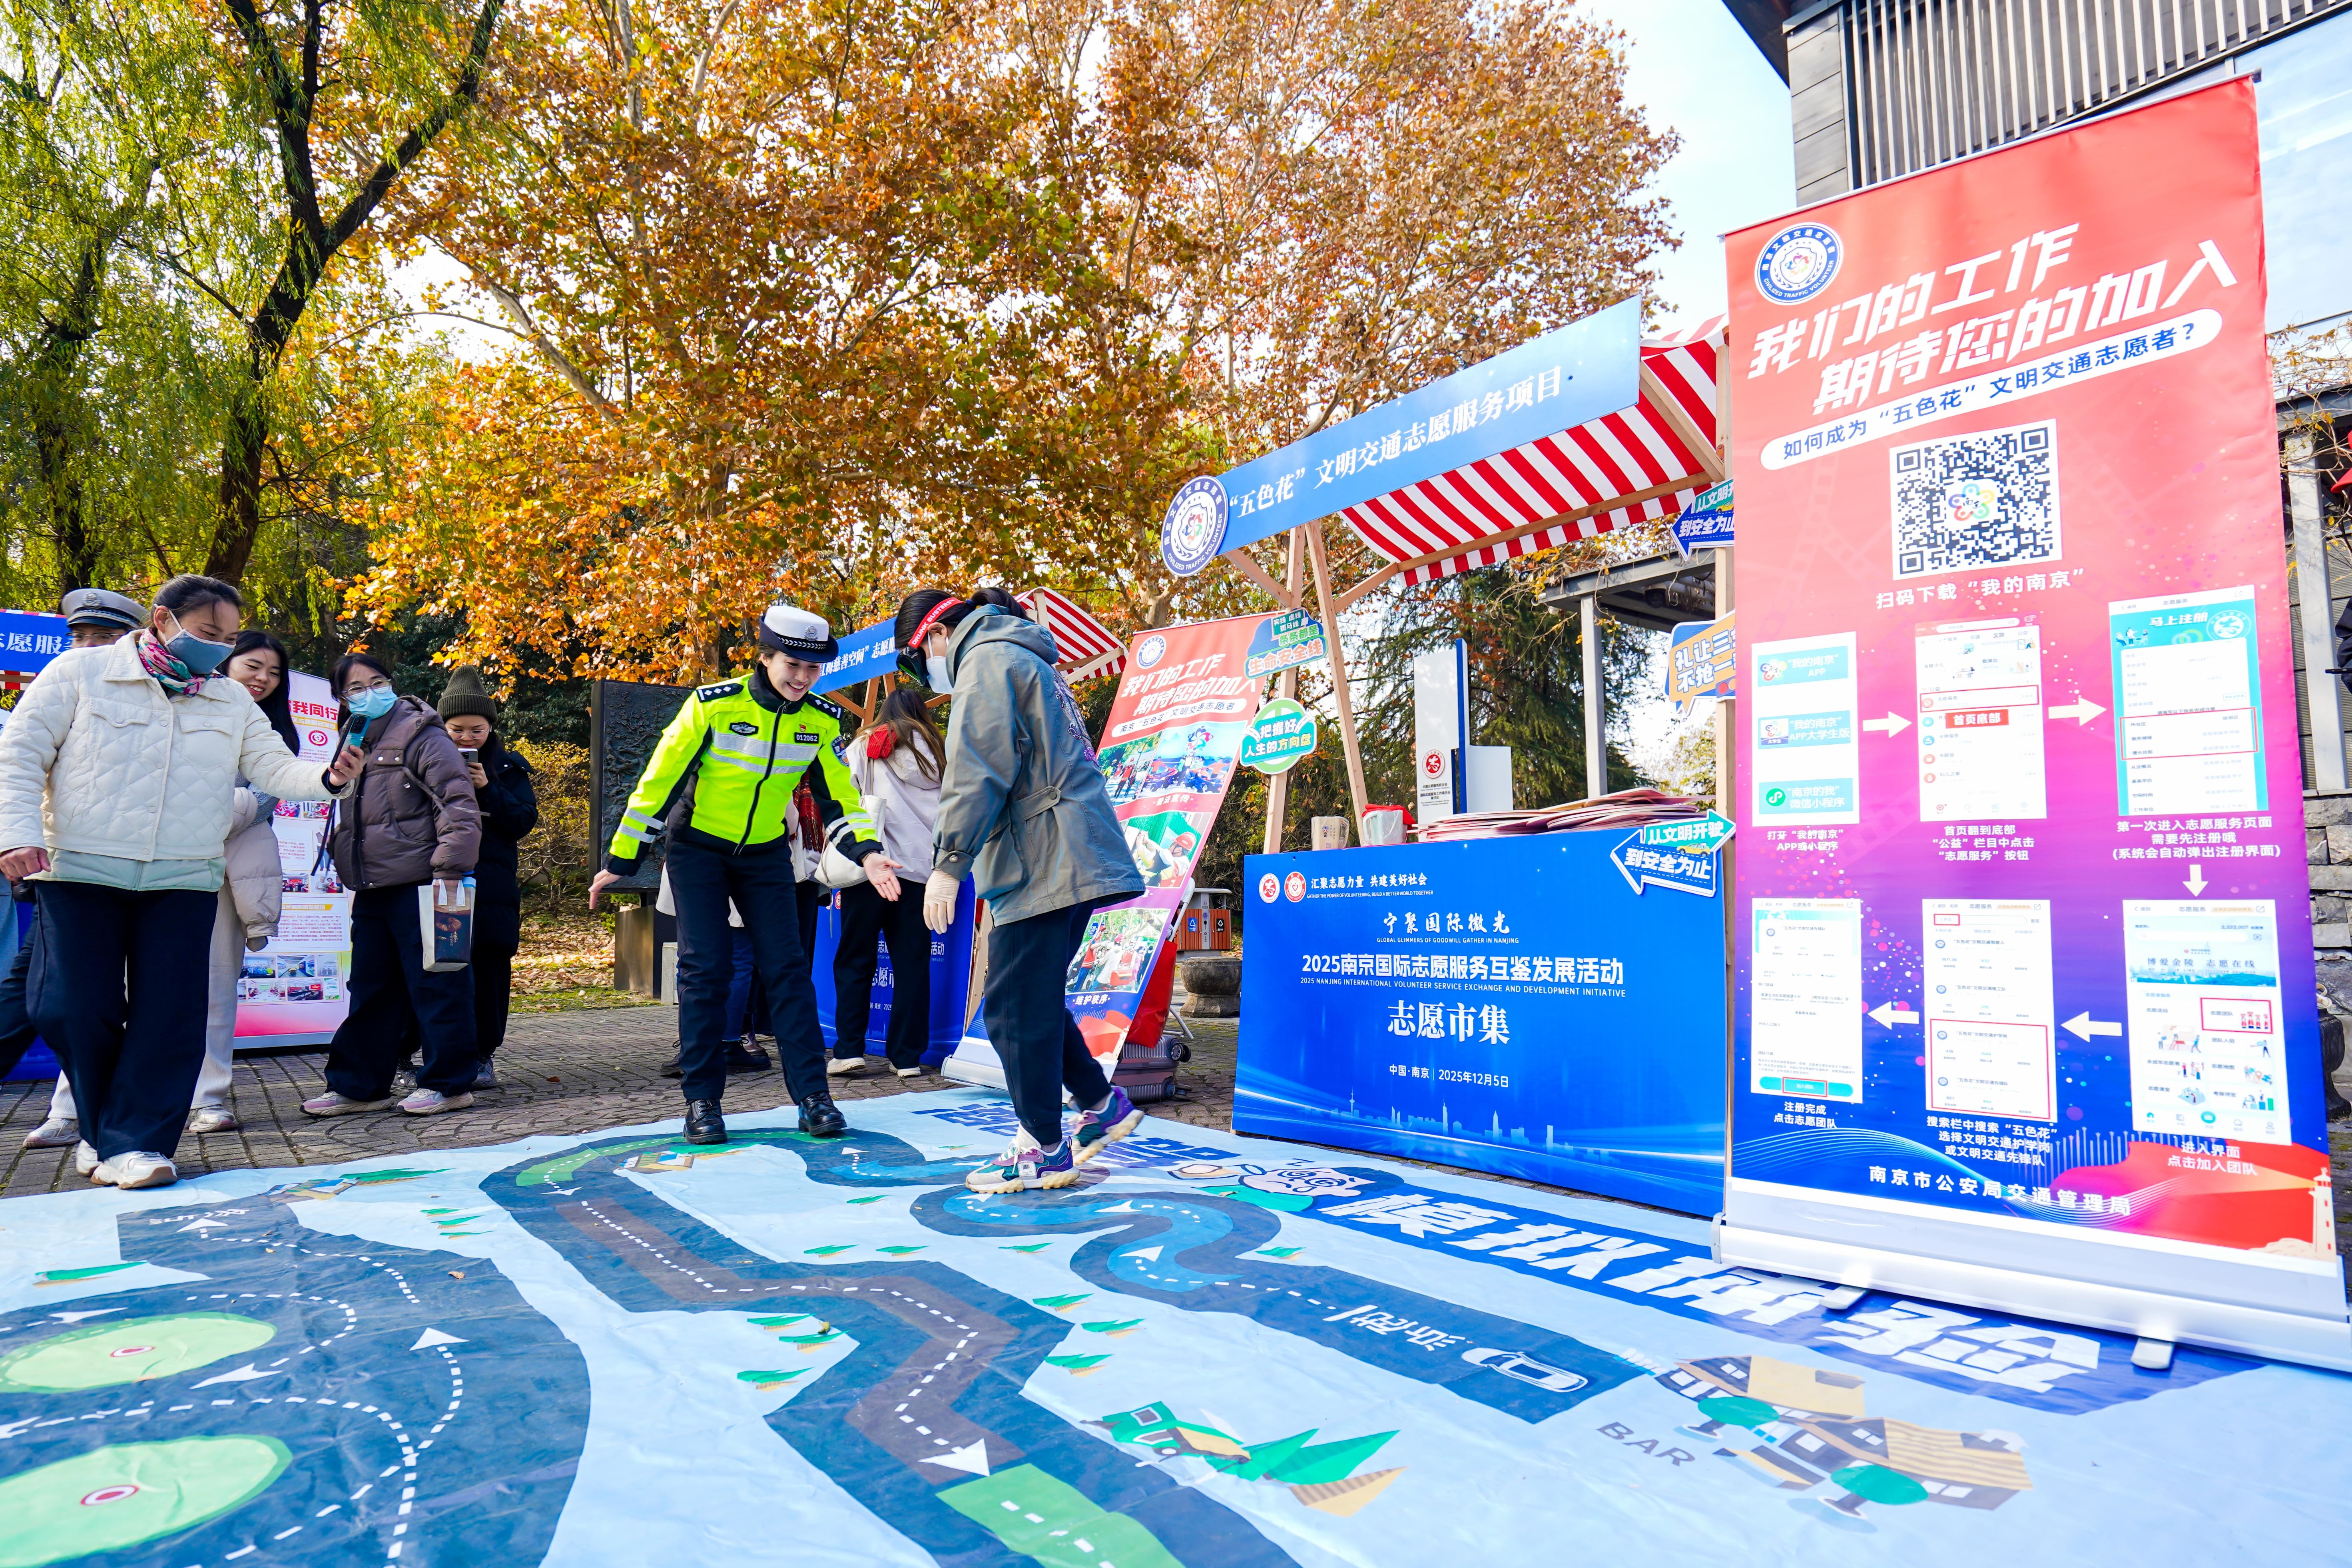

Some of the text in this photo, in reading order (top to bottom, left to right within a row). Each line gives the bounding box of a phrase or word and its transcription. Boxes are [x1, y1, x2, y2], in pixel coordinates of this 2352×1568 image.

[1762, 229, 1835, 271] 南京文明交通志愿者
[1764, 260, 1834, 298] CIVILIZED TRAFFIC VOLUNTEER
[1747, 223, 2078, 379] 我们的工作
[1812, 239, 2237, 415] 期待您的加入
[1164, 482, 1222, 546] 南京文明交通志愿者
[1167, 513, 1222, 570] CIVILIZED TRAFFIC VOLUNTEER
[1876, 568, 2084, 610] 扫码下载“我的南京”
[1274, 612, 1302, 626] 实线 虚线
[1280, 620, 1299, 632] 斑马线
[2149, 612, 2208, 628] 马上注册
[0, 632, 72, 655] 愿服
[912, 622, 929, 645] DRUNK
[1280, 624, 1319, 646] 条条都是
[1248, 638, 1324, 675] 生命安全线
[1675, 625, 1735, 672] 礼让三
[1121, 653, 1226, 697] 我们的工作
[1677, 652, 1735, 693] 不抢一
[1808, 668, 1826, 677] APP
[1133, 675, 1256, 716] 期待您的加入
[288, 700, 338, 721] 我同行
[1953, 712, 2001, 725] 首页底部
[1260, 718, 1297, 739] 把握好
[1789, 727, 1850, 741] APP大学生版
[1245, 733, 1312, 758] 人生的方向盘
[1790, 797, 1845, 809] 微信小程序
[1648, 821, 1724, 845] 从文明开驶
[1944, 825, 2016, 836] 首页翻到底部
[2117, 816, 2272, 832] 第一次进入志愿服务页面
[1777, 841, 1838, 851] APP或小程序
[2151, 832, 2237, 845] 需要先注册哦
[1624, 848, 1712, 880] 到安全为止
[1311, 875, 1364, 889] 汇聚志愿力量
[1370, 872, 1427, 887] 共建美好社会
[1383, 911, 1510, 934] 宁聚国际微光
[931, 941, 944, 956] 活动
[1302, 953, 1623, 985] 2025南京国际志愿服务互鉴发展活动
[2147, 958, 2255, 968] 博爱金陵 志愿在线
[1074, 994, 1108, 1005] 维护秩序
[1343, 979, 1392, 987] INTERNATIONAL
[1465, 983, 1502, 992] EXCHANGE
[1524, 986, 1580, 995] DEVELOPMENT
[1583, 988, 1626, 997] INITIATIVE
[1387, 1000, 1510, 1044] 志愿市集
[1389, 1064, 1509, 1088] 中国·南京 2025年12月5日
[1784, 1101, 1826, 1115] 注册完成
[1774, 1113, 1837, 1128] 点击志愿团队
[1938, 1130, 2050, 1153] 选择文明交通护学岗
[2181, 1141, 2240, 1158] 进入界面
[1945, 1145, 2045, 1166] 或文明交通先锋队
[2168, 1155, 2258, 1176] 点击加入团队
[1869, 1165, 2131, 1216] 南京市公安局交通管理局
[1317, 1193, 2101, 1393] 模拟体验
[1596, 1422, 1695, 1467] BAR
